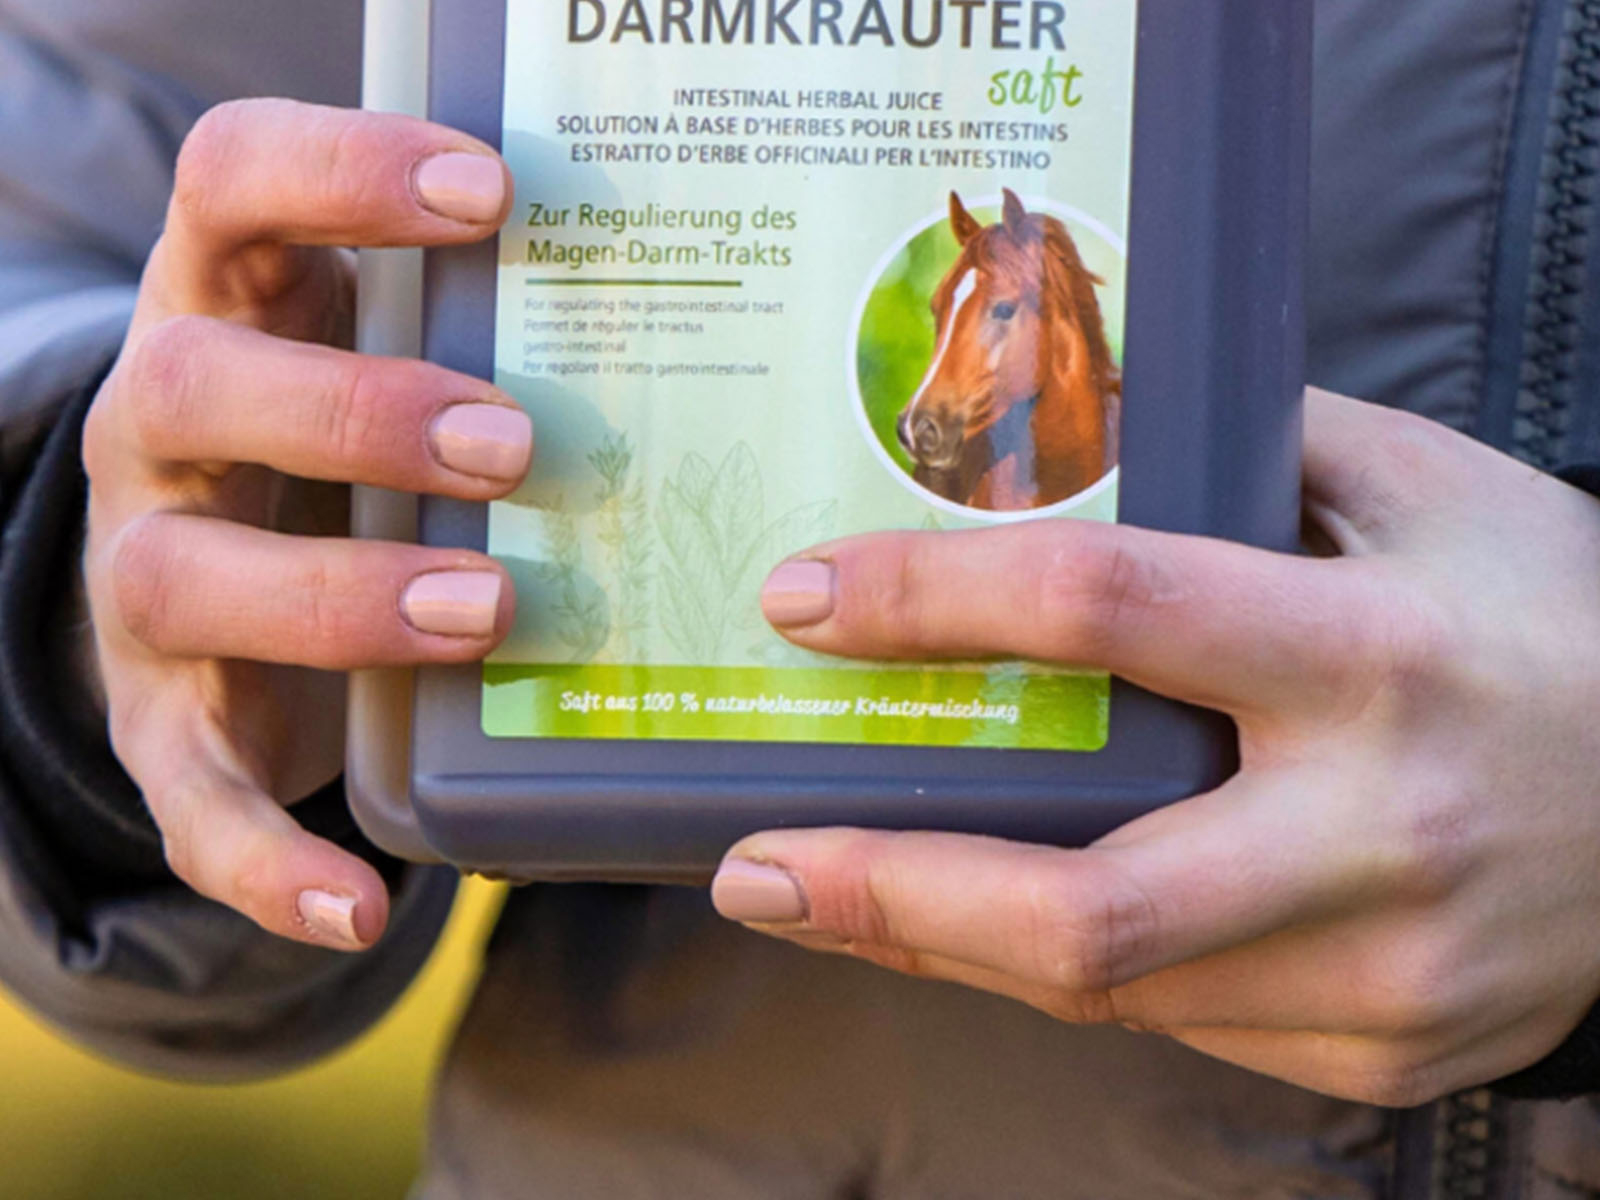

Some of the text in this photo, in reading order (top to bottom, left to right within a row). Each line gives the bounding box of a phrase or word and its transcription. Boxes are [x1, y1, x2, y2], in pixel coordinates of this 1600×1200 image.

[674, 89, 943, 111] INTESTINAL HERBAL JUICE
[987, 56, 1084, 114] saft
[557, 112, 1069, 142] SOLUTION À BASE D'HERBES POUR LES INTESTINS
[571, 143, 1052, 171] ESTRATTO D'ERBE OFFICINALI PER L'INTESTINO
[527, 202, 798, 236] Zur Regulierung des
[526, 238, 793, 270] Magen-Darm-Trakts
[619, 300, 641, 312] the
[752, 301, 784, 313] tract
[559, 690, 602, 714] Saft
[642, 692, 676, 712] 100
[680, 692, 699, 713] %
[855, 696, 1019, 725] Kräutermischung
